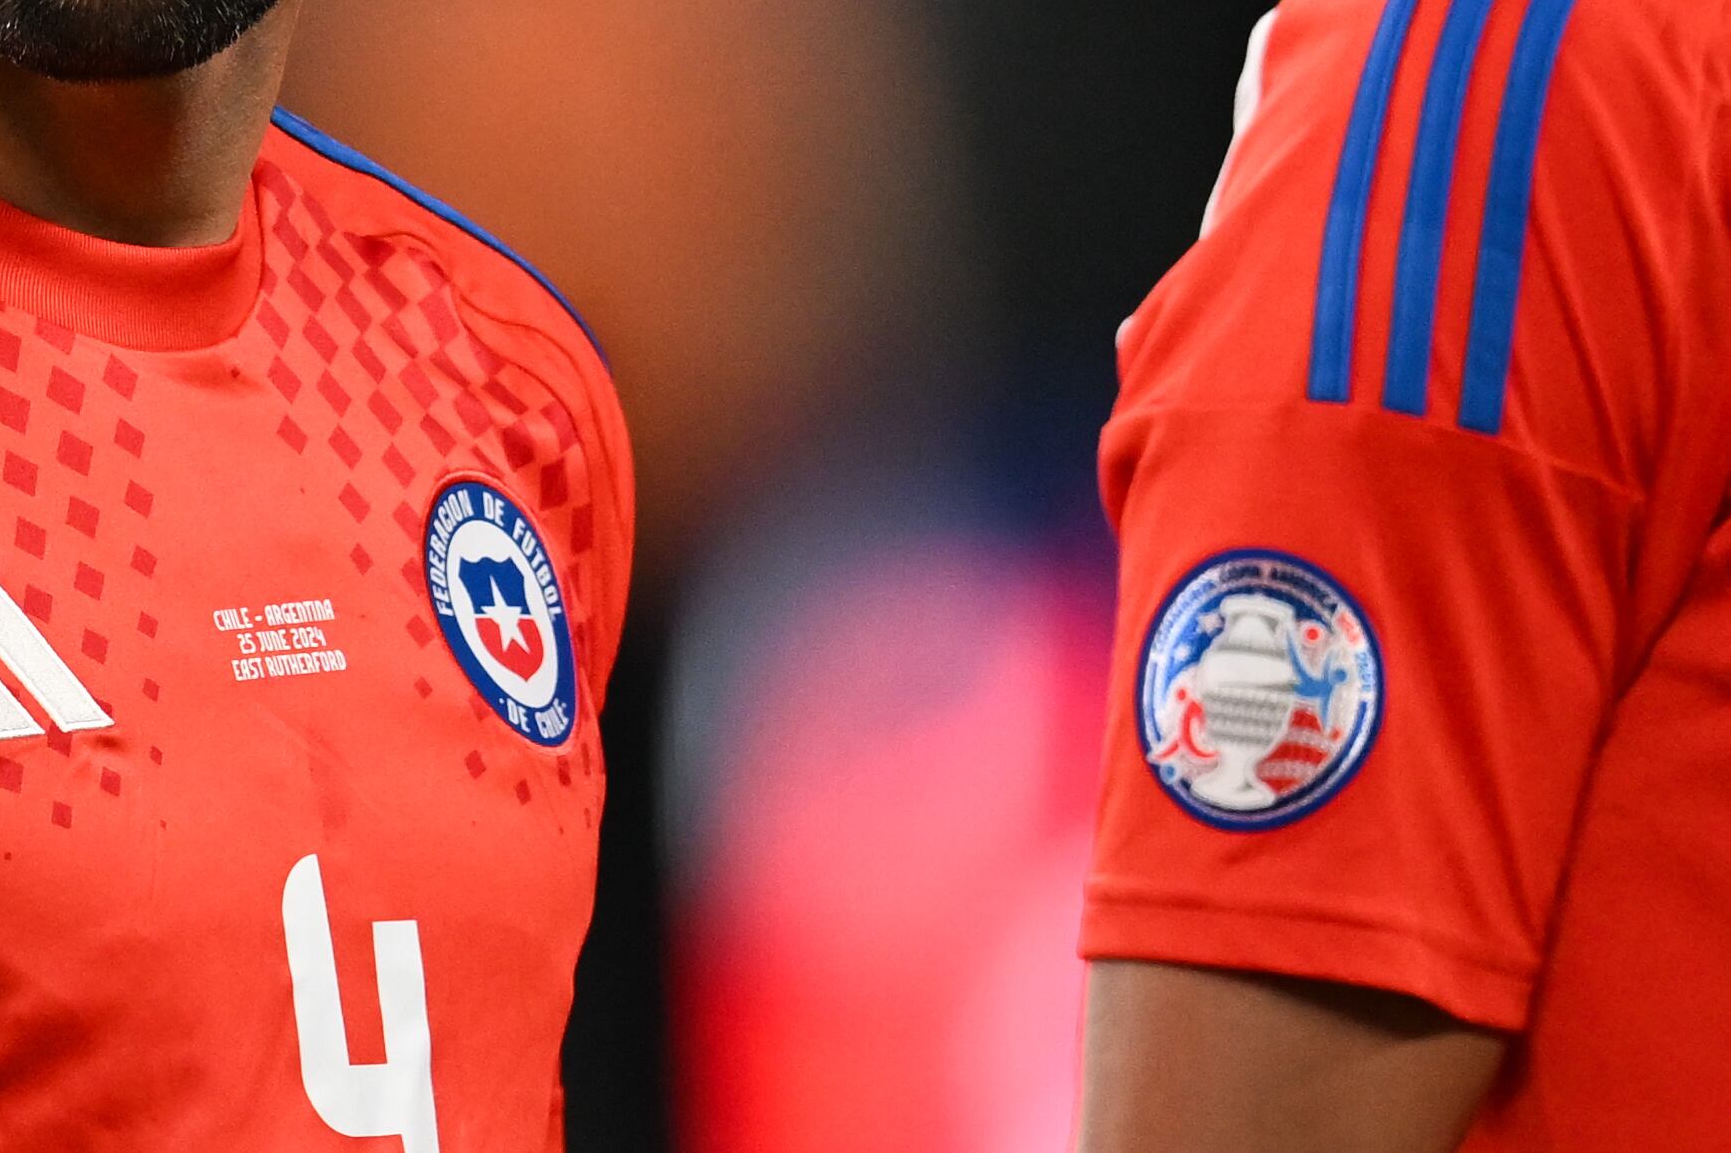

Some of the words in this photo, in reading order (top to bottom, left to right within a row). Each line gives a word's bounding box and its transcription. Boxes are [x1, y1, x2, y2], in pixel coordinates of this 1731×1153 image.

[429, 489, 474, 617] FEDERACION
[482, 491, 504, 527] DE
[512, 517, 562, 621] FUTBOL
[213, 607, 254, 631] CHILE
[264, 599, 336, 626] ARGENTINA
[237, 633, 256, 654] 25
[255, 629, 291, 652] JUNE
[292, 626, 327, 650] 2024
[231, 655, 265, 681] EAST
[264, 650, 347, 678] RUTHERFORD
[507, 697, 531, 733] DE
[534, 697, 569, 739] CHILE
[281, 853, 440, 1153] 4
